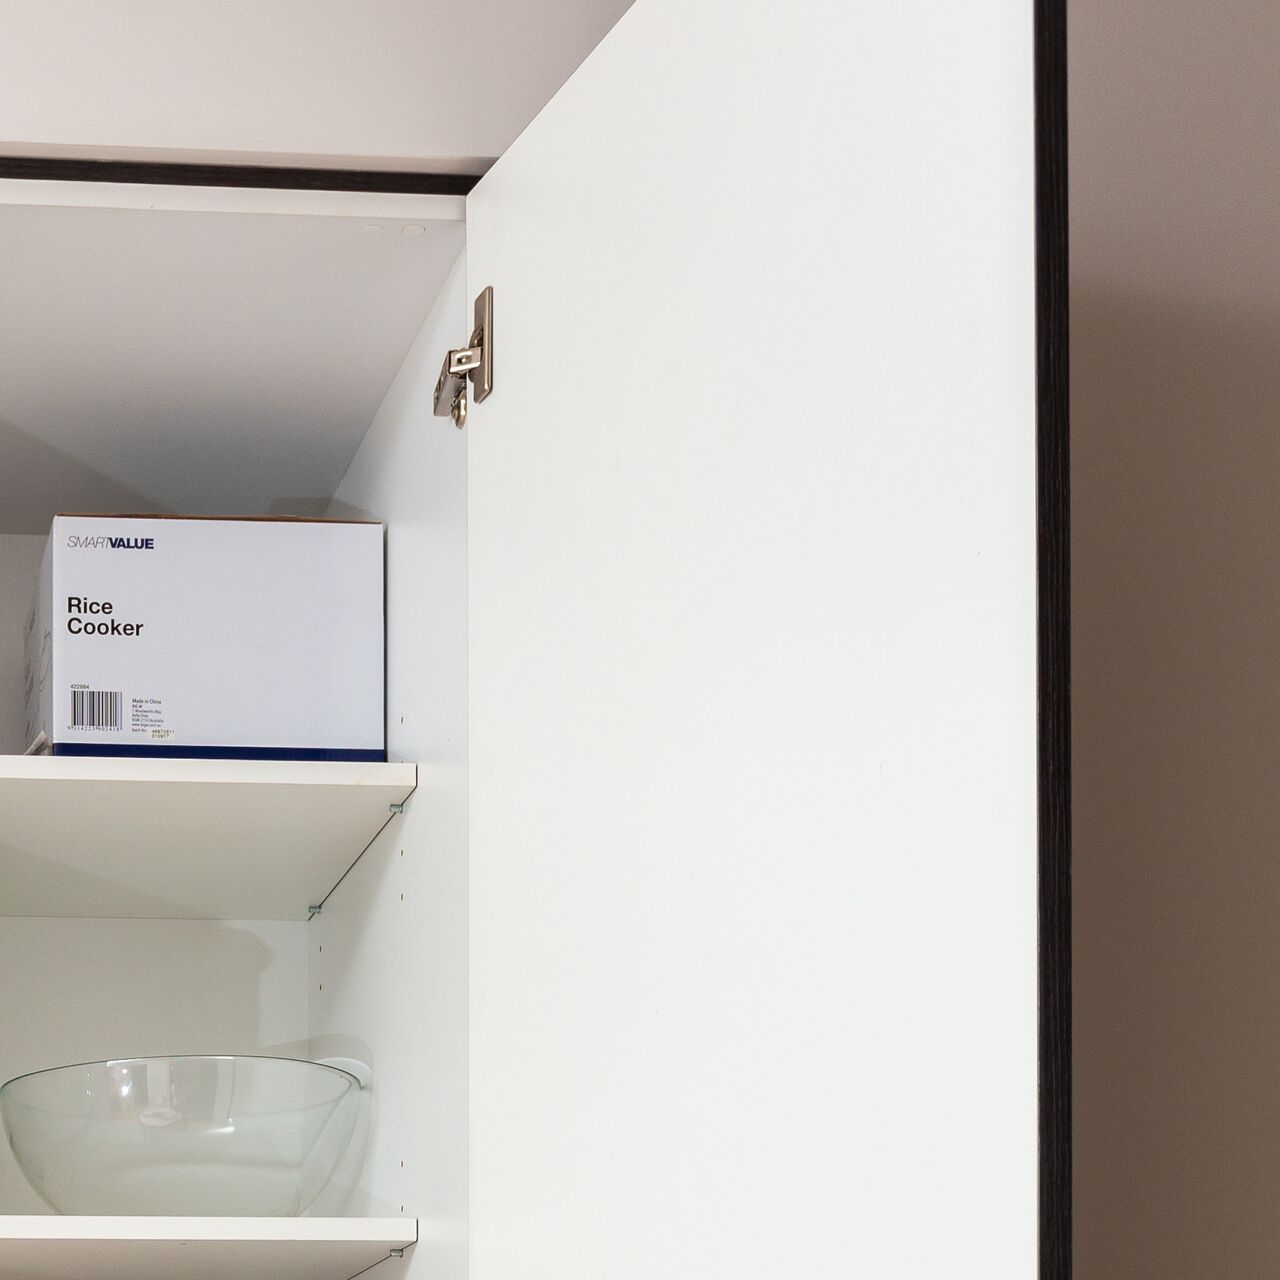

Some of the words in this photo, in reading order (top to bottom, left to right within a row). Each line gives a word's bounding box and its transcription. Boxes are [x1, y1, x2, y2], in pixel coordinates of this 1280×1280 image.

[67, 536, 154, 549] SMARTVALUE
[68, 597, 113, 614] Rice
[67, 617, 144, 636] Cooker
